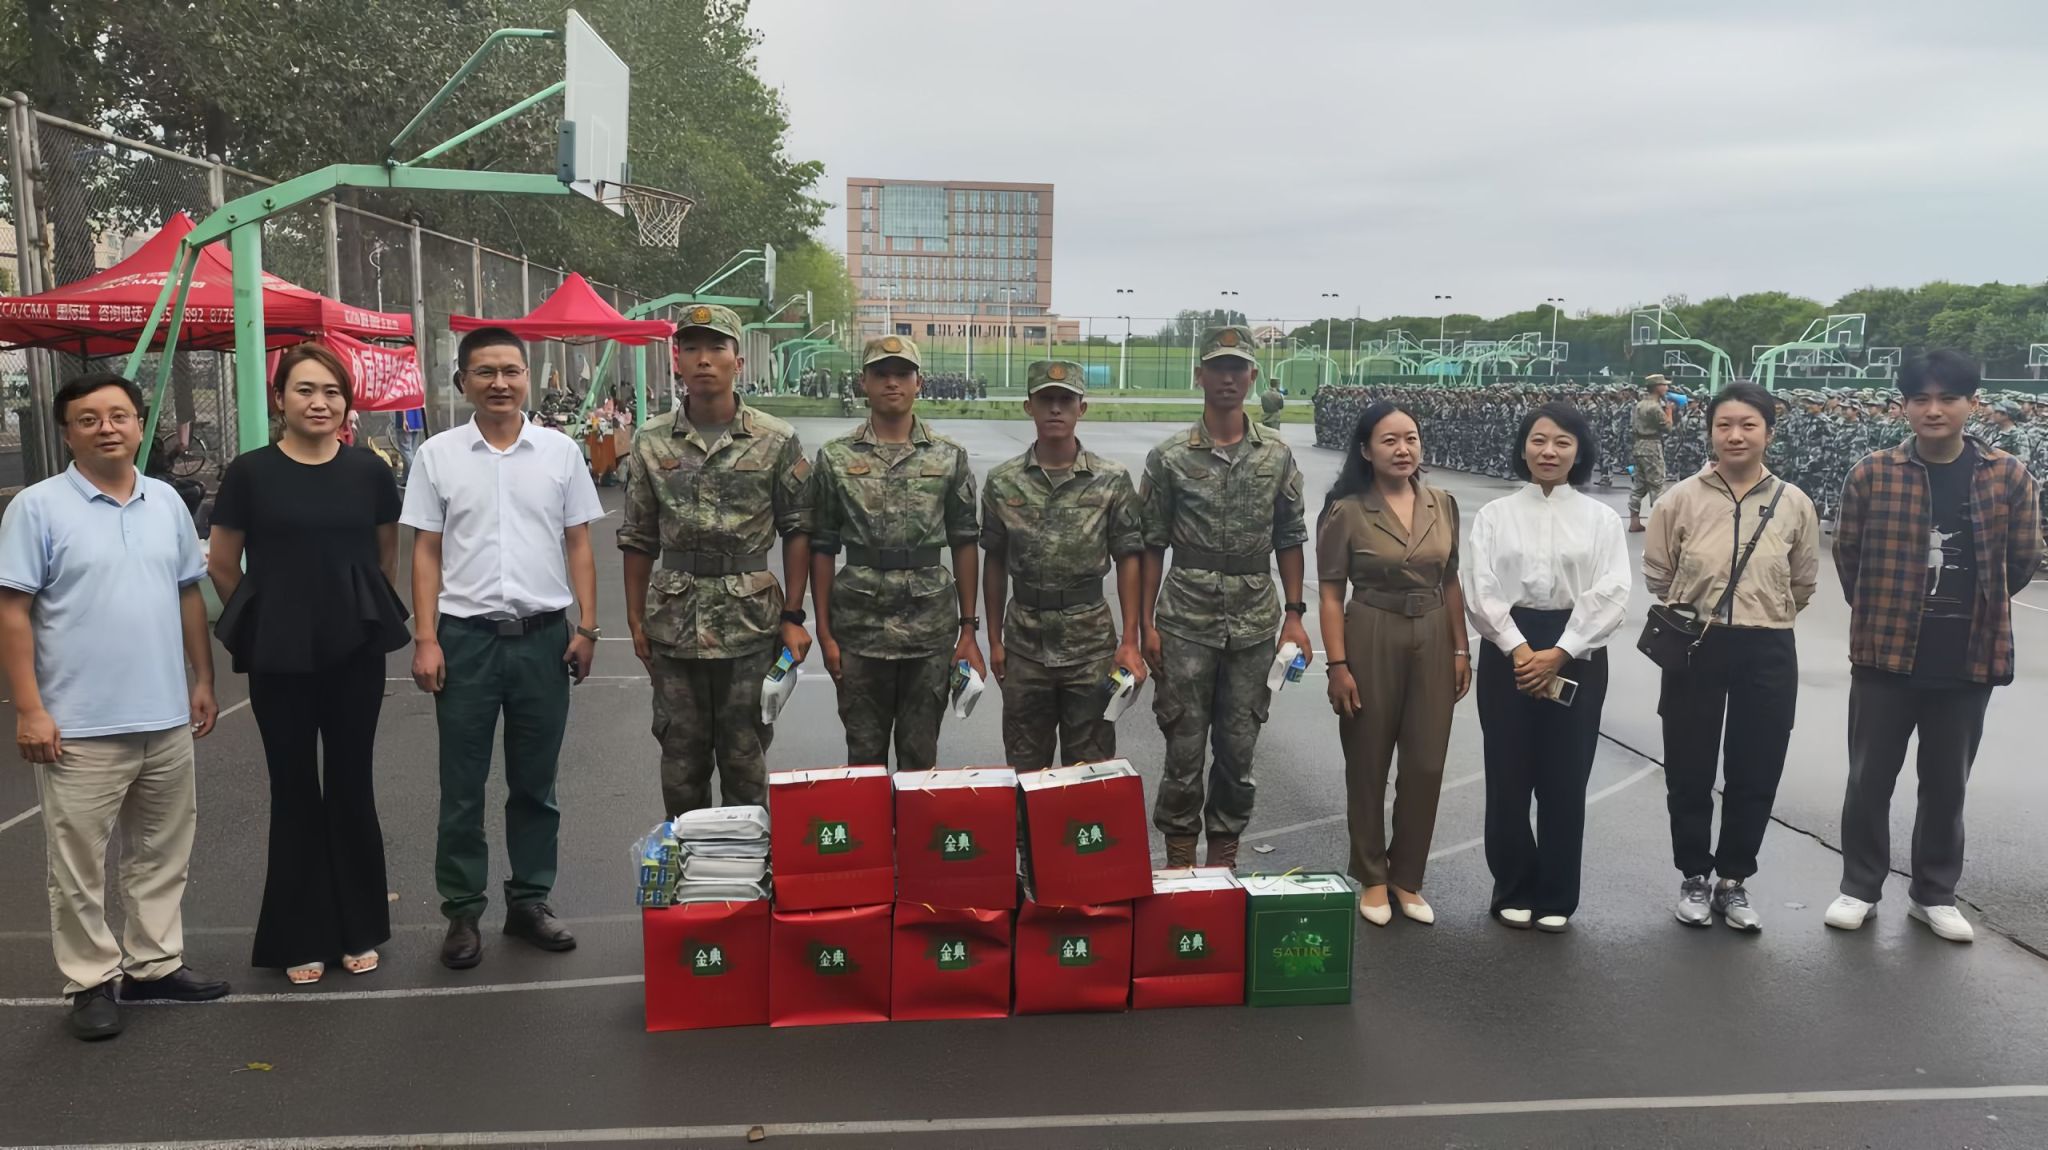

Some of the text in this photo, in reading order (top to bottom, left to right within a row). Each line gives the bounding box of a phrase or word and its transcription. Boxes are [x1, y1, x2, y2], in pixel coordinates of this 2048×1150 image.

[0, 302, 50, 320] CA/CMA
[57, 303, 91, 320] 国际班
[820, 824, 847, 845] 金典
[944, 832, 971, 852] 金典
[1077, 824, 1103, 846] 金典
[940, 941, 966, 961] 金典
[1062, 938, 1088, 958] 金典
[1179, 933, 1203, 953] 金典
[1272, 945, 1333, 958] SATINE
[695, 947, 722, 967] 金典
[819, 949, 845, 967] 金典
